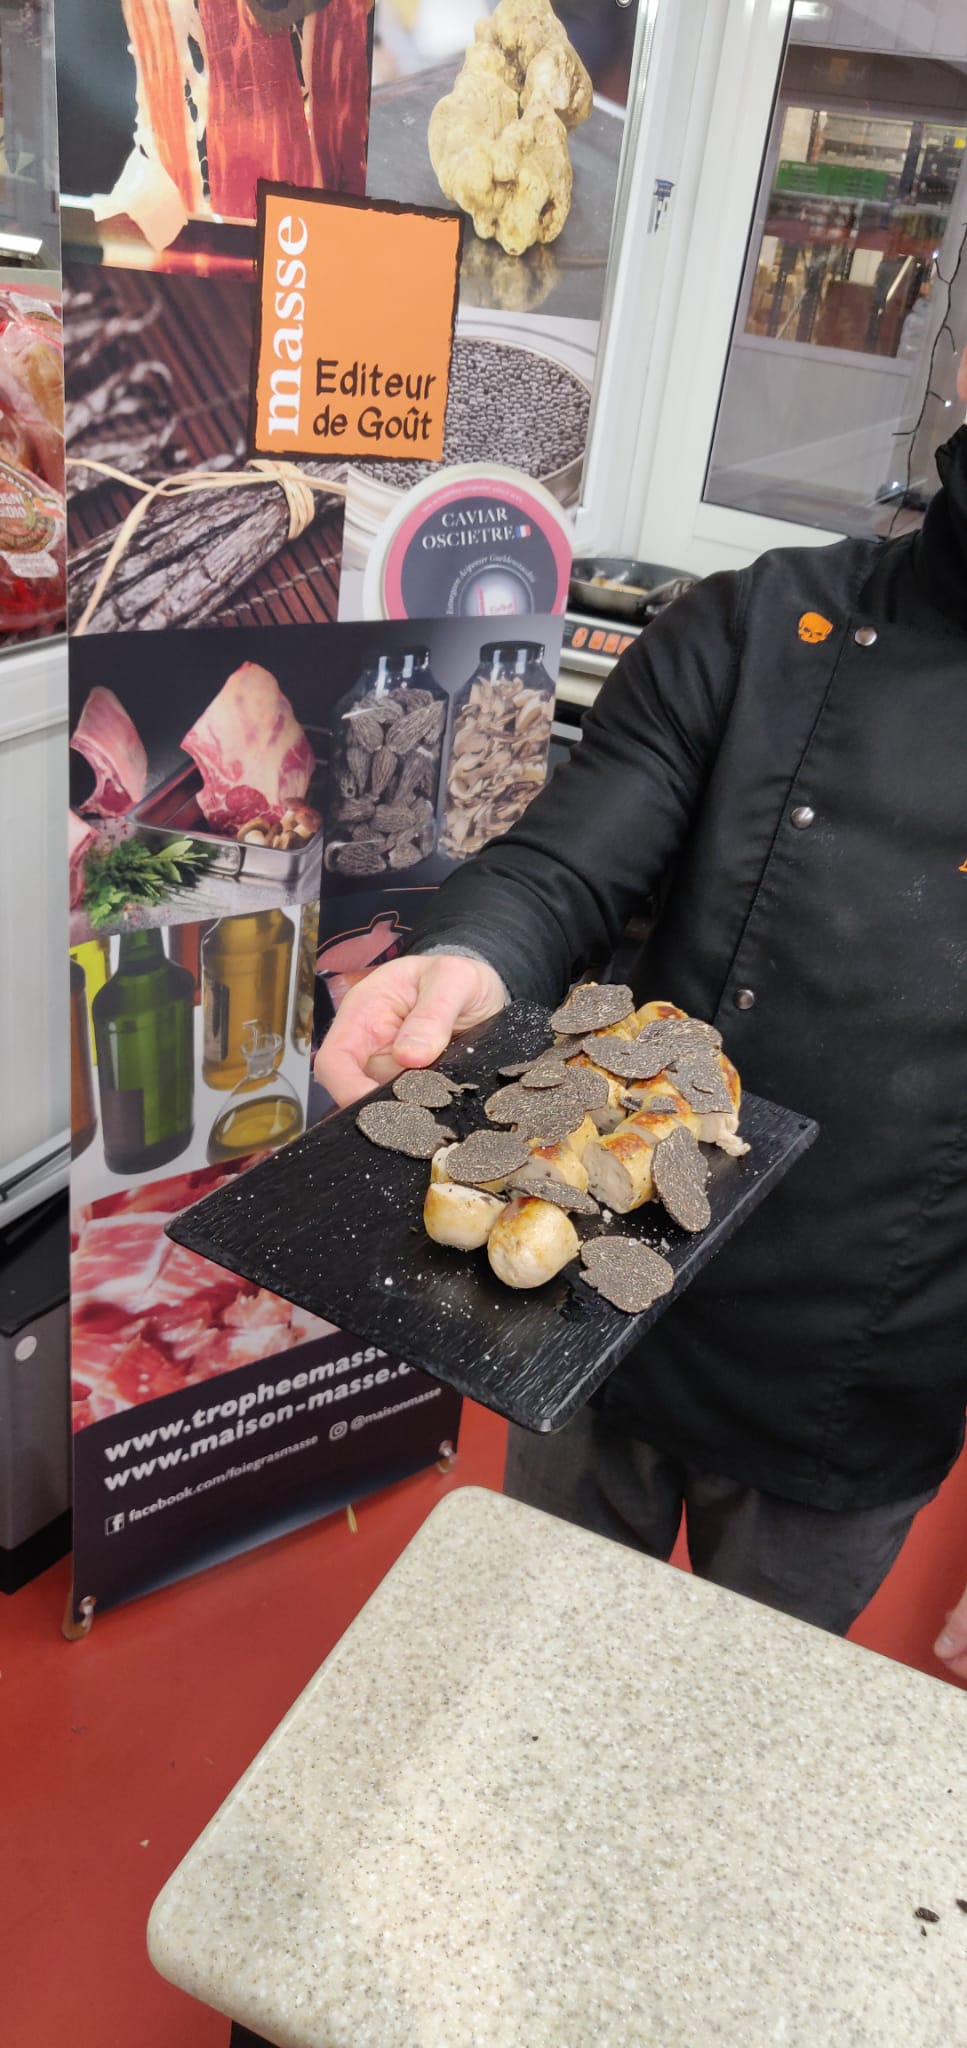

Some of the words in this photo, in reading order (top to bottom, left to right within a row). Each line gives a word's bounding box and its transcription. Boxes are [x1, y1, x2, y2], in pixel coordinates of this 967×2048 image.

[267, 215, 309, 437] masse
[315, 357, 437, 401] Editeur
[312, 404, 348, 438] de
[357, 405, 433, 442] Goût
[421, 524, 516, 550] OSCIETRE
[441, 507, 509, 528] CAVIAR
[103, 1361, 413, 1491] www.maison-masse.c
[350, 1387, 442, 1432] @maisonmasse
[128, 1435, 319, 1523] facebook.com/foiegrasmasse
